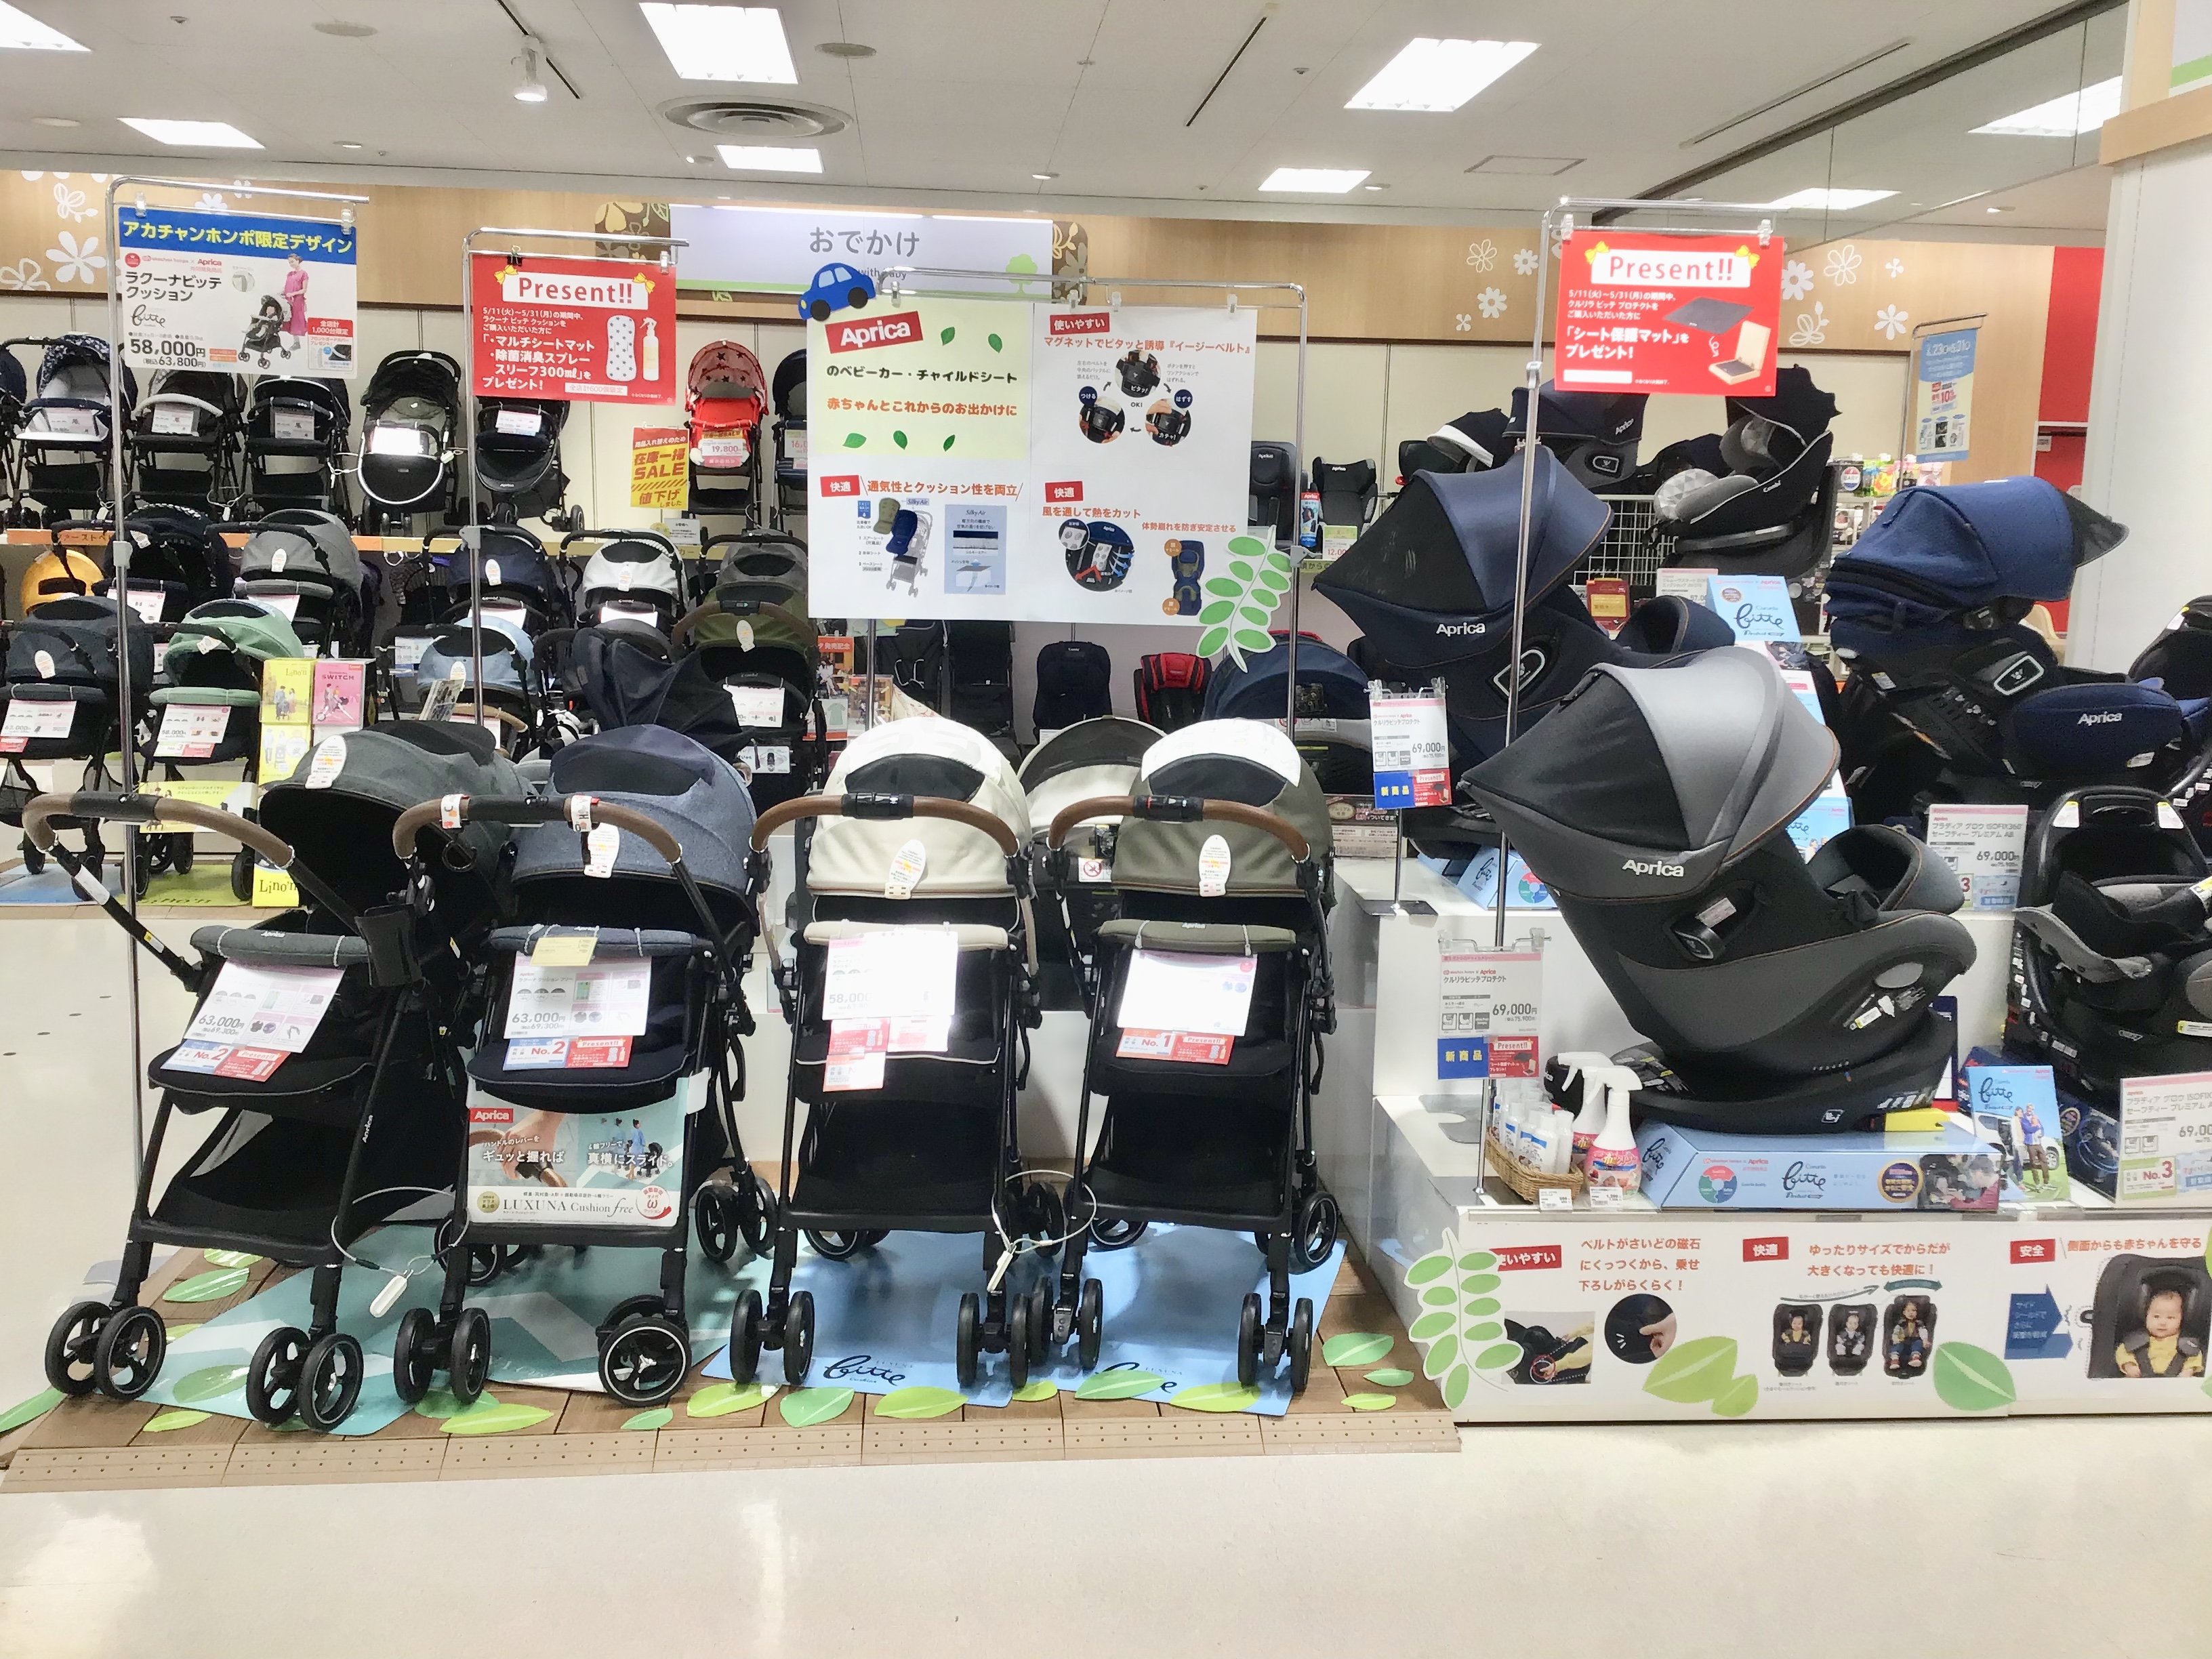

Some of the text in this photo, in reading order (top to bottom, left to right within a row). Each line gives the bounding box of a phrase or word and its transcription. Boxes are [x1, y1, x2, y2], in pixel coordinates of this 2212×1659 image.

[123, 221, 352, 253] アカチャンホンポ限定デザイン
[809, 226, 920, 257] おでかけ
[197, 258, 222, 266] Aprica
[1610, 256, 1733, 281] Present!!
[125, 272, 222, 289] ラクーナビッテ
[126, 286, 193, 302] クッション
[519, 277, 632, 304] Present!!
[483, 325, 552, 334] ご購入いただいた方に
[1054, 318, 1105, 331] 使いやすい
[840, 321, 911, 348] Aprica
[130, 339, 206, 357] 58,000円
[1565, 345, 1633, 359] プレゼント!
[827, 365, 1017, 384] のベビーカー・チャイルドシート
[483, 377, 543, 390] プレゼント!
[827, 398, 1017, 416] 赤ちゃんとこれからのお出かけに
[634, 448, 685, 466] 在庫一掃
[634, 462, 685, 480] SALE
[830, 482, 852, 493] 快適
[867, 480, 1017, 496] 通気性とクッション性を両立
[1054, 487, 1075, 498] 快適
[640, 489, 680, 505] 値下げ
[1042, 506, 1141, 518] 風を通して熱をカット
[1142, 523, 1236, 533] 体勢崩れを防ぎ安定させる
[1436, 622, 1486, 637] Aprica
[2077, 712, 2123, 726] Aprica
[1412, 742, 1446, 753] 69,000円
[1622, 859, 1684, 878] Aprica
[1492, 1004, 1537, 1016] 69,000円
[512, 1012, 565, 1023] 63,000円
[531, 1040, 565, 1055] No.2
[474, 1111, 510, 1120] Aprica
[485, 1136, 539, 1147] ハンドルのレバーを
[483, 1150, 565, 1163] ギュッと握れば
[588, 1151, 673, 1167] 真横にスライド。
[2144, 1160, 2173, 1181] No.3
[504, 1197, 634, 1217] LUXUNA Cushion free
[1581, 1237, 1701, 1252] ベルトがさいどの磁石
[1753, 1244, 1779, 1257] 快適
[1809, 1242, 1951, 1256] ゆったりサイズでからだが
[2020, 1246, 2044, 1257] 安全
[2068, 1238, 2202, 1251] 側面からも赤ちゃんを守る
[1580, 1258, 1700, 1272] にくっつくから、乗せ
[1807, 1264, 1935, 1276] 大きくなっても快適に!
[1578, 1279, 1684, 1292] 下ろしがらくらく!
